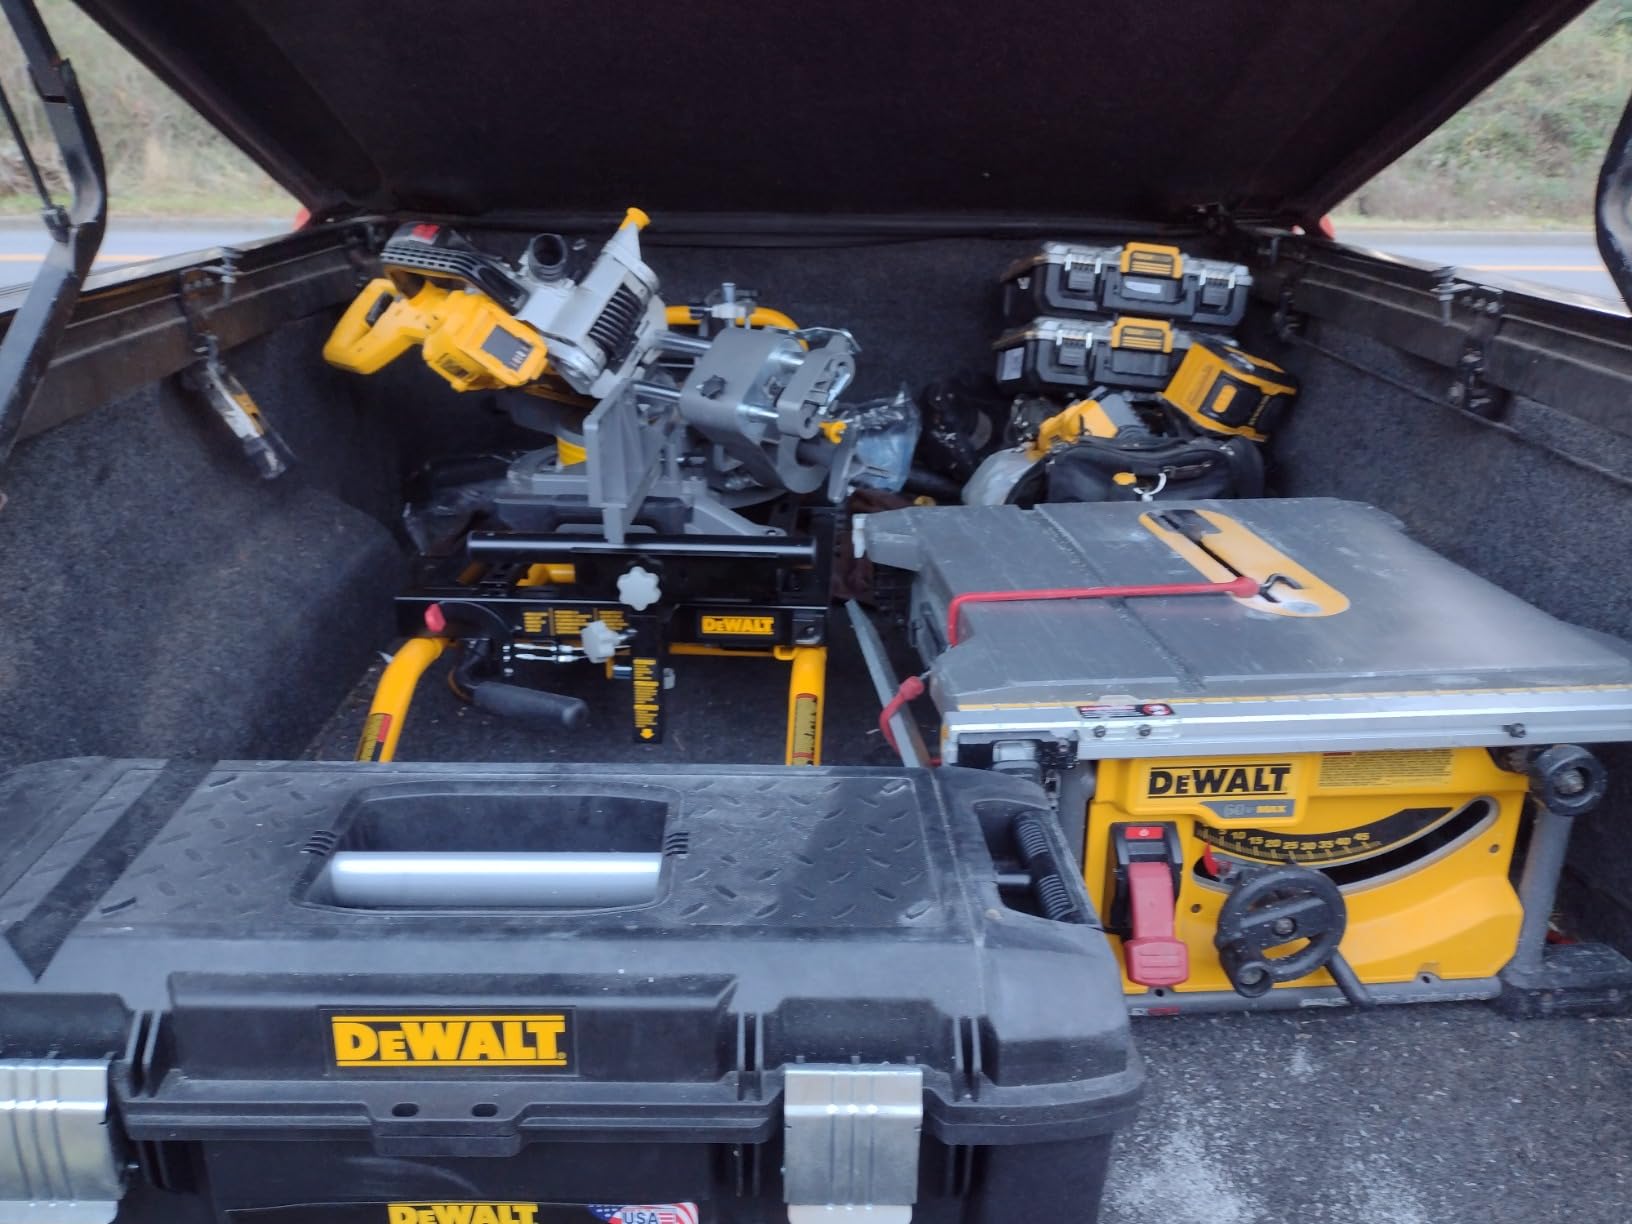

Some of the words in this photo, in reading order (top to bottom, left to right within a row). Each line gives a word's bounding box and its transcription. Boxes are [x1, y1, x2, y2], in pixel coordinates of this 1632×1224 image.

[1149, 767, 1291, 795] DEWALT
[1231, 831, 1247, 840] 10
[1249, 836, 1265, 845] 15
[1264, 838, 1282, 848] 20
[1282, 841, 1299, 850] 25
[1318, 840, 1335, 849] 35
[1353, 832, 1370, 841] 45
[332, 1021, 566, 1060] DEWALT
[624, 1212, 659, 1224] USA
